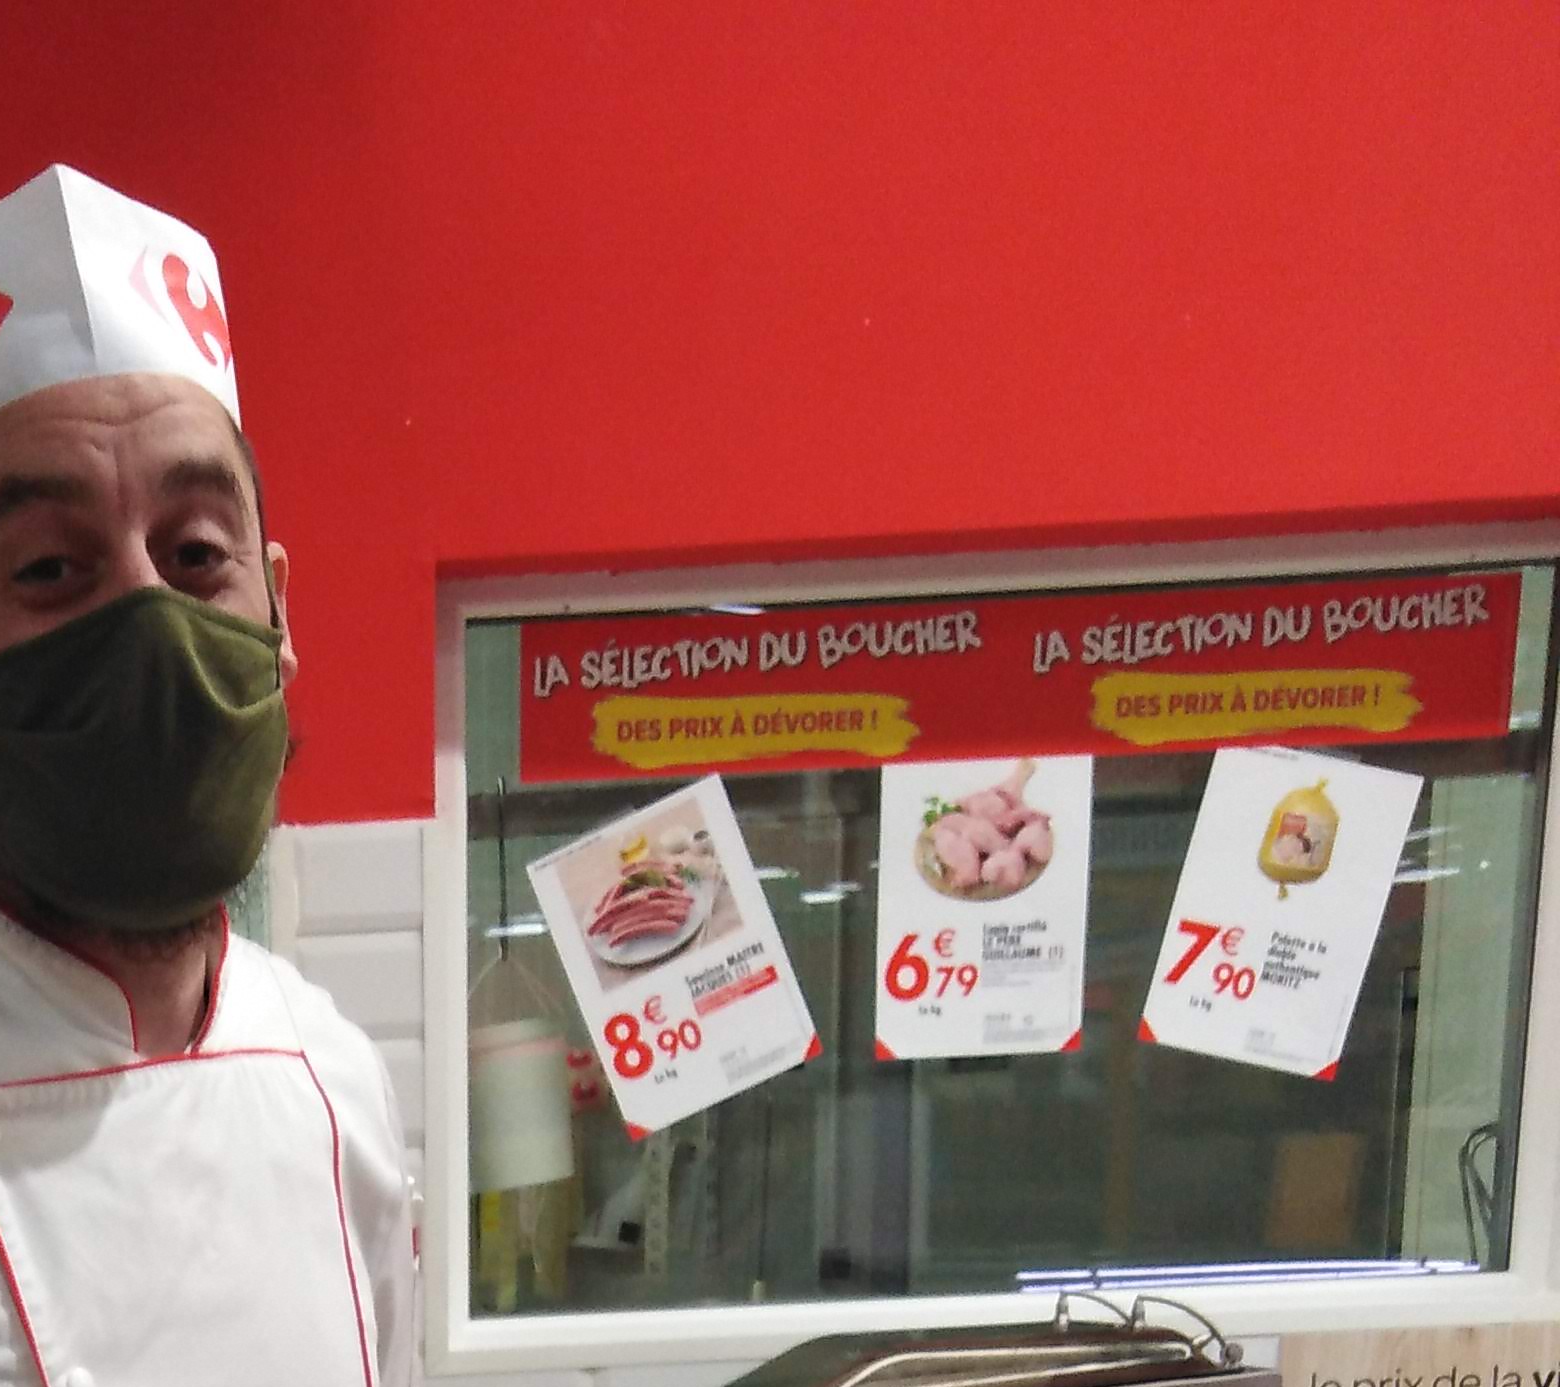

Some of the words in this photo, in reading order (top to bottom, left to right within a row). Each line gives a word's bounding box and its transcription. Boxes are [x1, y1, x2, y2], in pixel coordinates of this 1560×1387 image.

[534, 654, 569, 697] LA
[580, 634, 749, 689] SÉLECTION
[759, 630, 807, 671] DU
[818, 610, 981, 669] BOUCHER
[1033, 632, 1070, 673] LA
[1080, 614, 1253, 665] SÉLECTION
[1262, 605, 1311, 647] DU
[1324, 584, 1489, 643] BOUCHER
[617, 718, 661, 742] DES
[669, 714, 723, 739] PRIX
[730, 709, 747, 736] À
[754, 708, 863, 736] DÉVORER
[1116, 696, 1159, 718] DES
[1168, 691, 1224, 715] PRIX
[1230, 685, 1247, 712] À
[1254, 684, 1366, 712] DÉVORER
[884, 933, 930, 1001] 6
[936, 964, 979, 998] 79
[1163, 919, 1221, 985] 7
[1212, 962, 1256, 1001] 90
[603, 1013, 654, 1079] 8
[656, 1018, 702, 1061] 90
